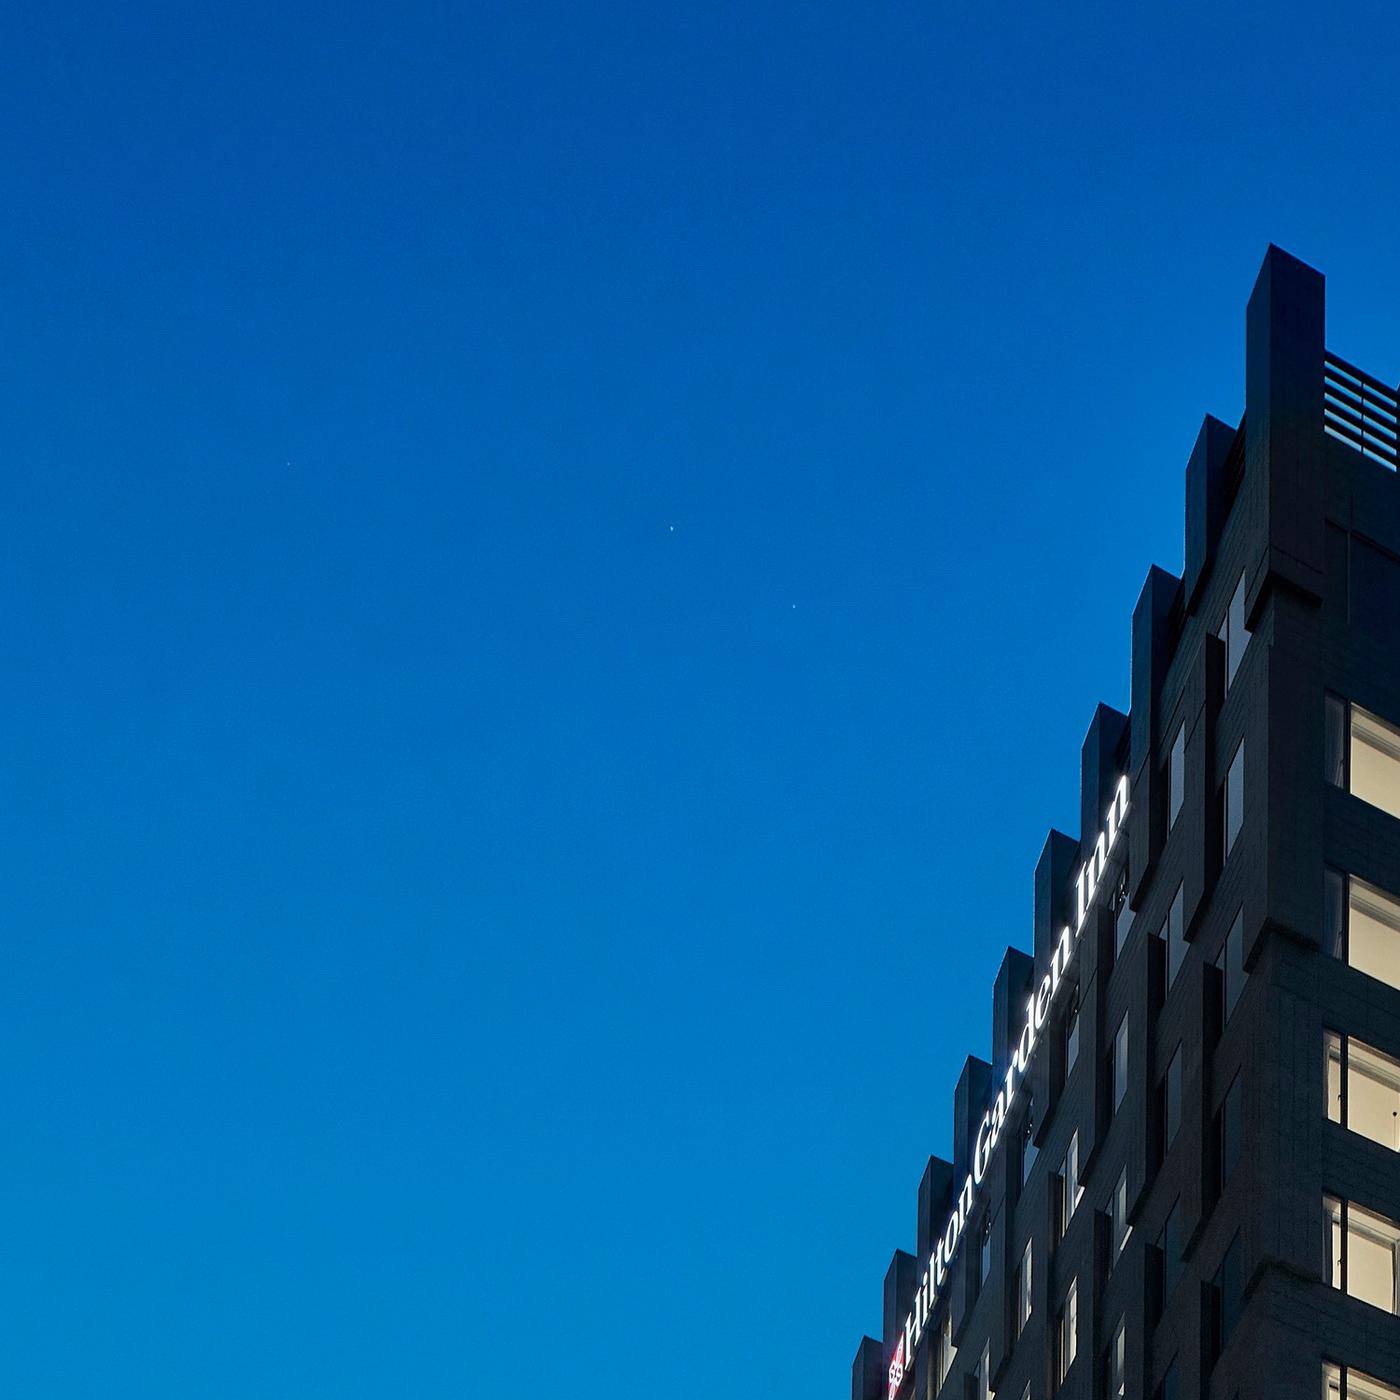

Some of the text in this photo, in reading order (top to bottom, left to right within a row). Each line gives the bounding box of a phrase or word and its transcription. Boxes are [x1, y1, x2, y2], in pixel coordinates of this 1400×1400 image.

[905, 775, 1129, 1371] Hilton Garden Inn
